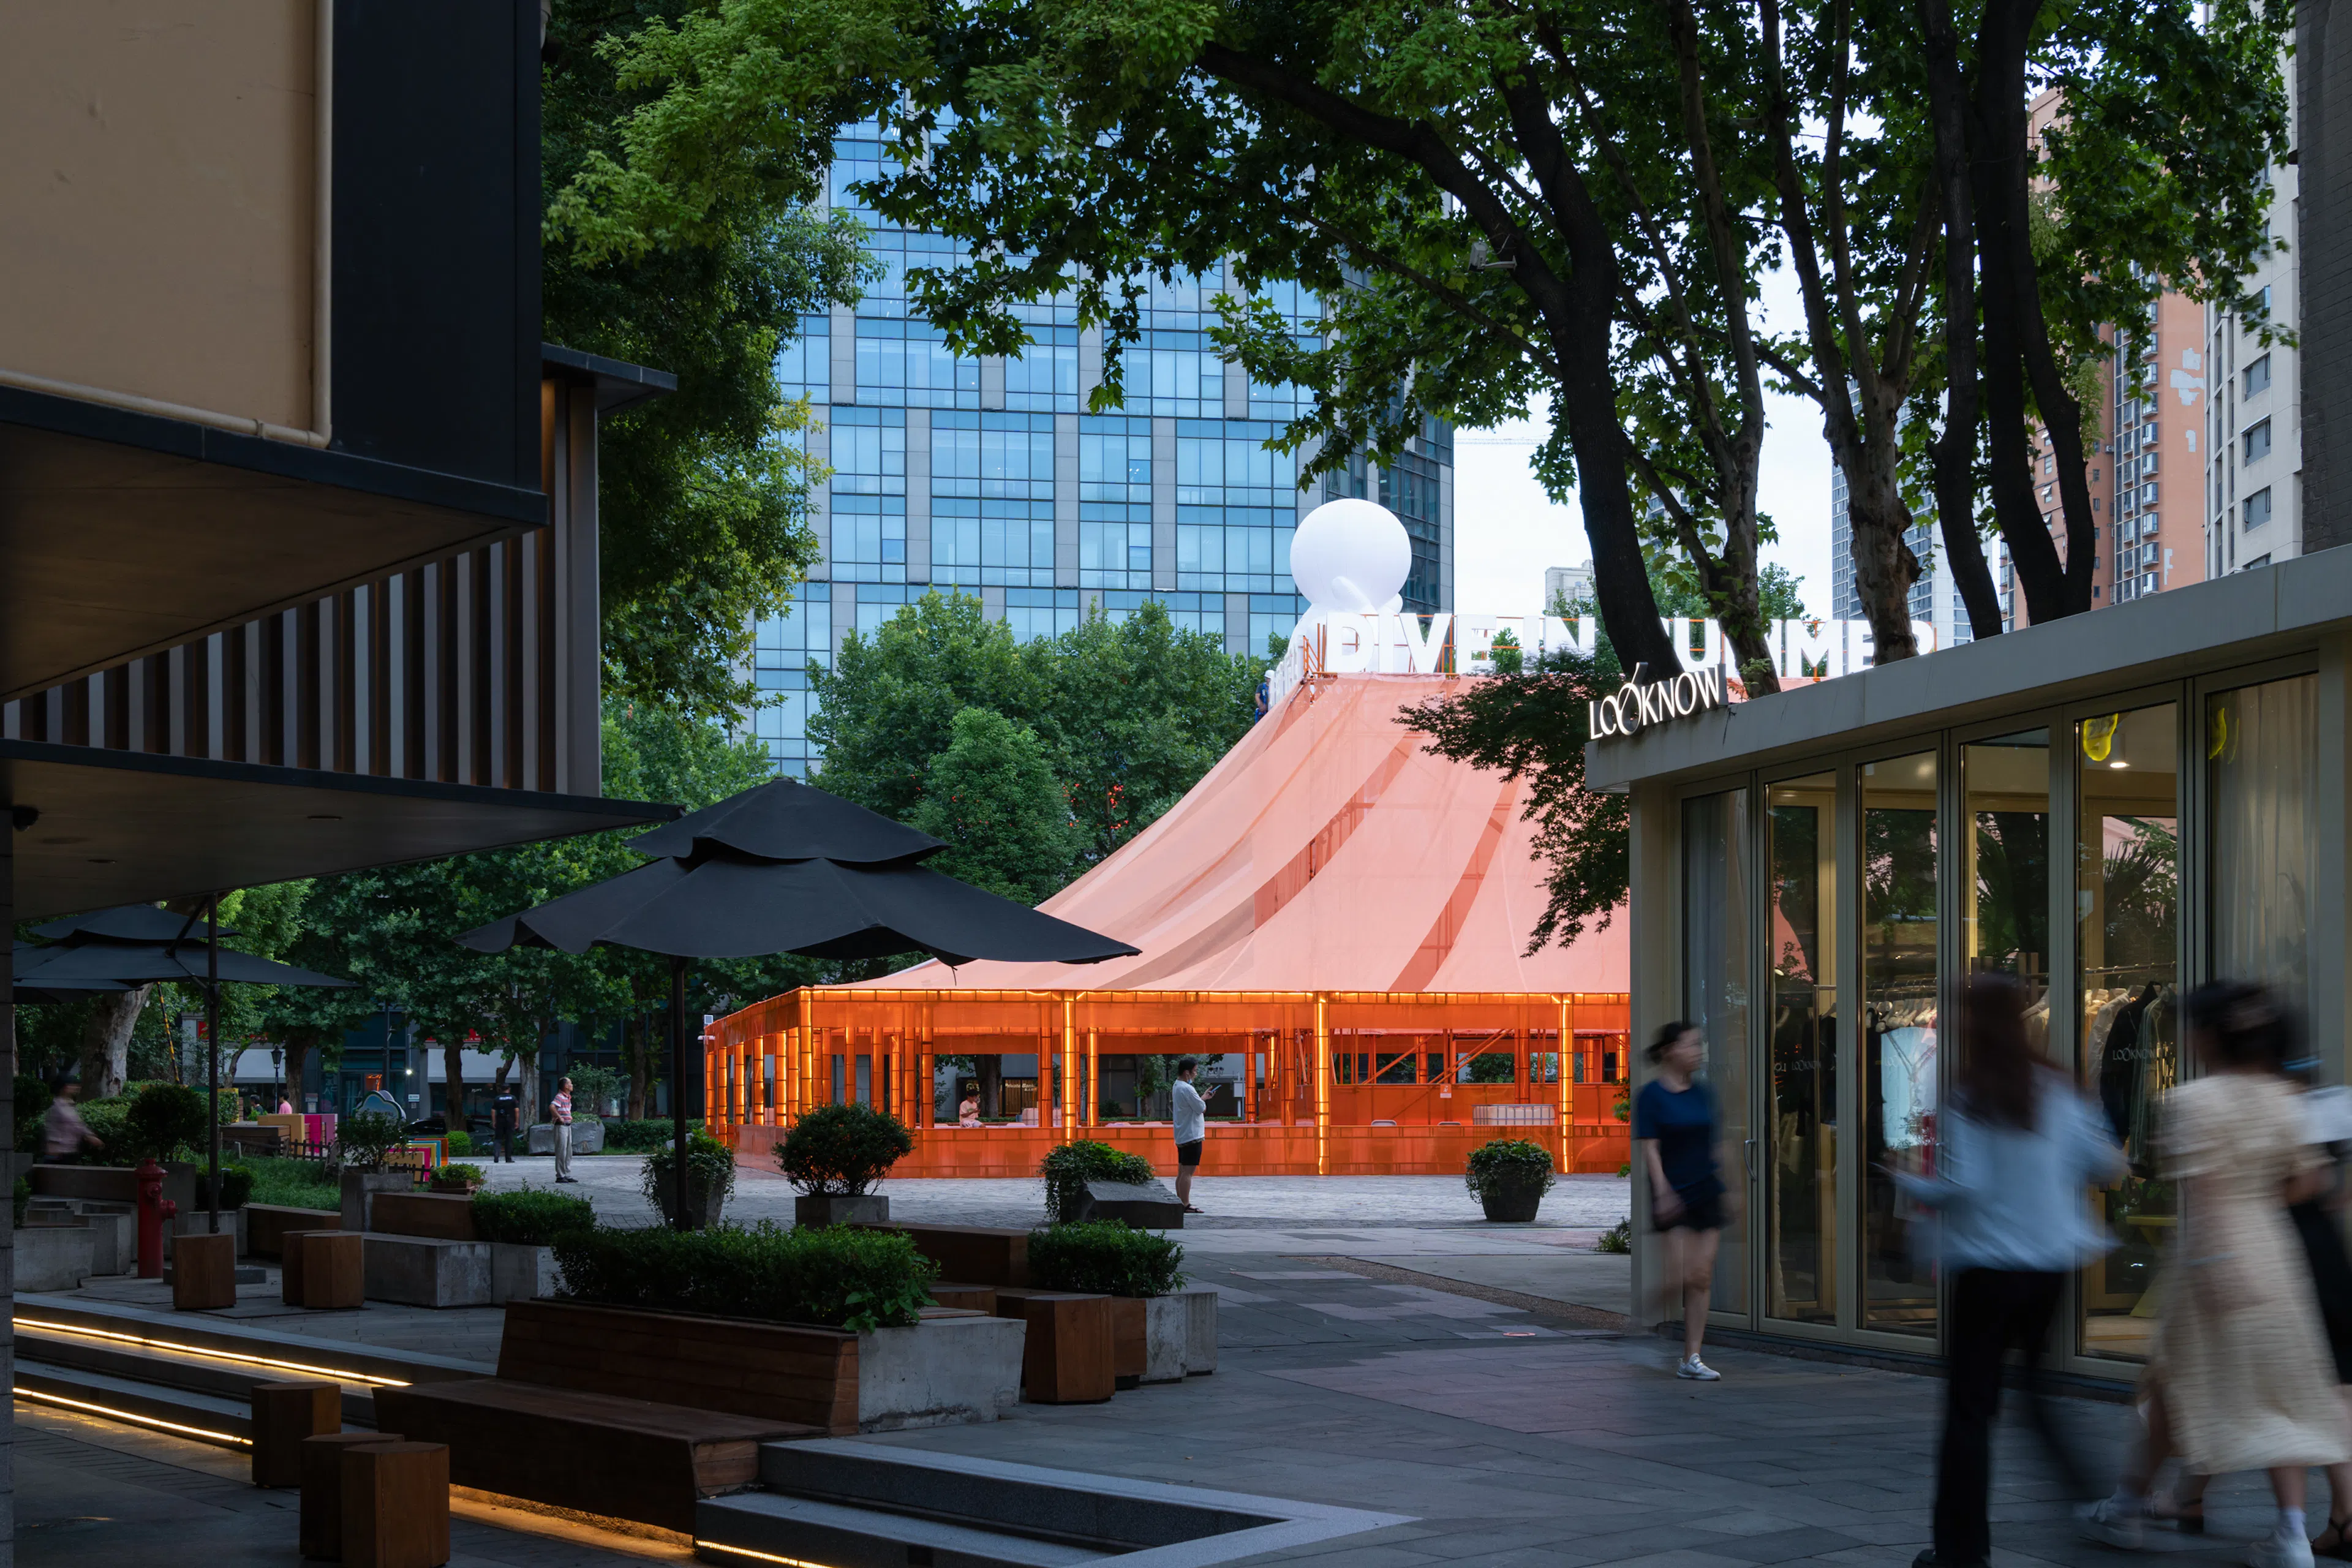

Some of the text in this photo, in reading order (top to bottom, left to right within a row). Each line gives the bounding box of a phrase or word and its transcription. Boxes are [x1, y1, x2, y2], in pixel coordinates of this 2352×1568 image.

[1327, 612, 1496, 674] DIVE
[1523, 615, 1595, 674] IN
[1660, 617, 1934, 678] UME
